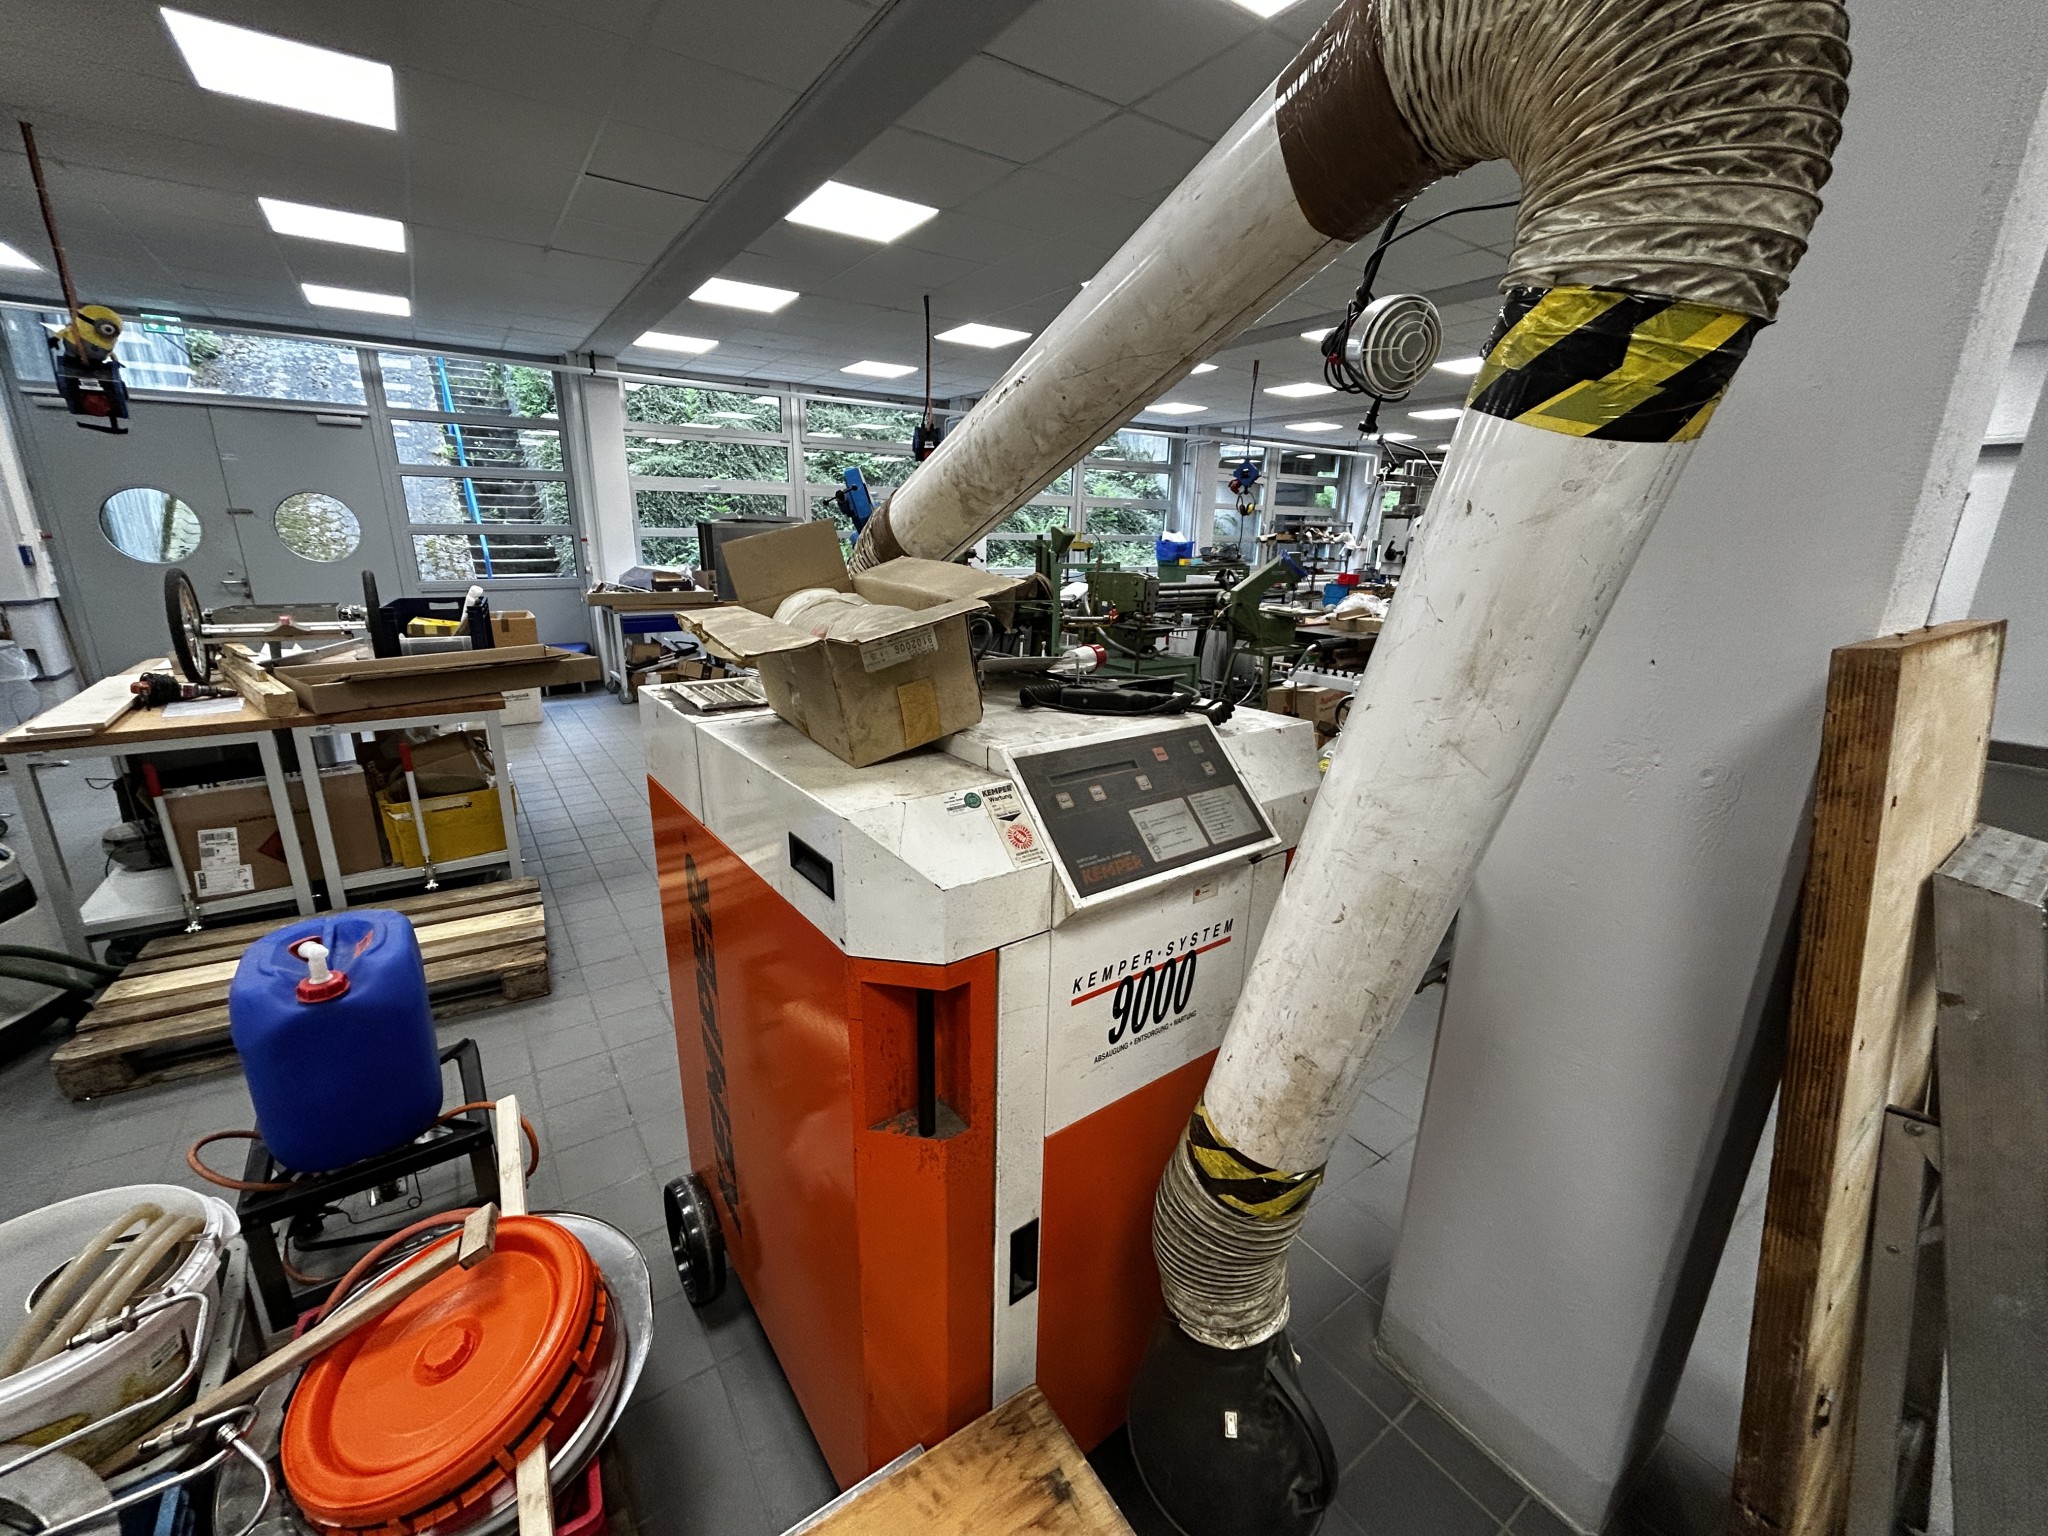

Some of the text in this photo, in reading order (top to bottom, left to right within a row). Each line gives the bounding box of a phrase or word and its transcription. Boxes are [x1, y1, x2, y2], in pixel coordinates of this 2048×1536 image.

[981, 785, 1012, 797] KEMPER
[989, 793, 1013, 803] Wartung
[1081, 854, 1144, 885] KEMPER
[1108, 949, 1197, 1045] 9000
[1093, 1009, 1197, 1064] ABSAUGUNG ENTSORGUNG WARTUNG
